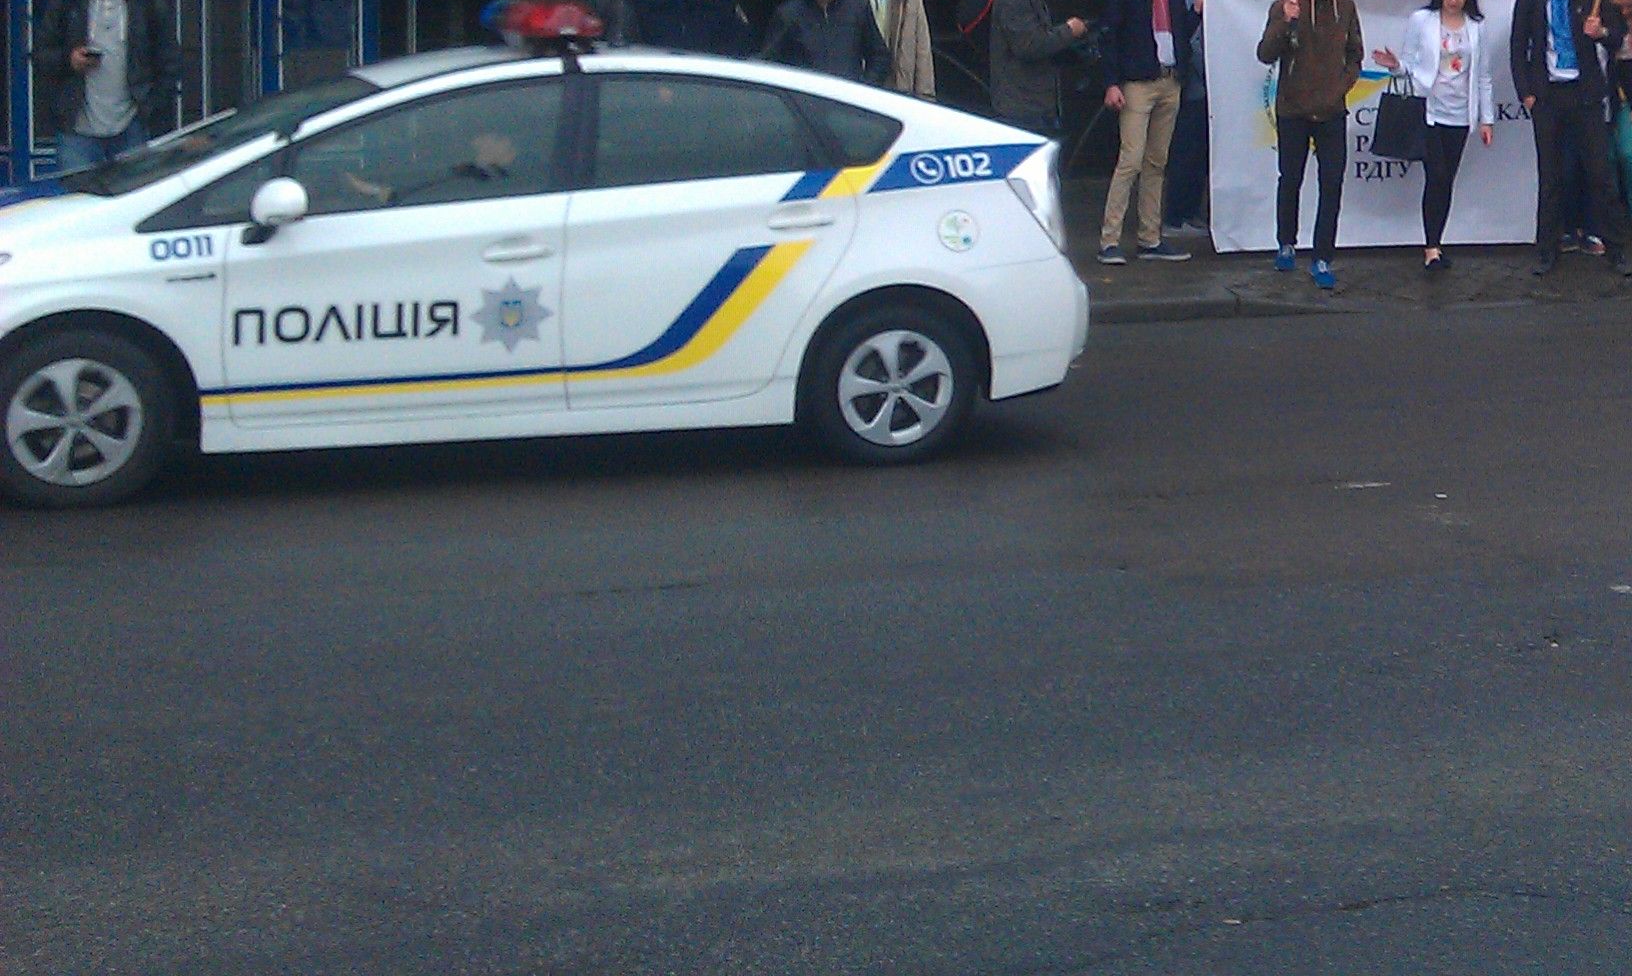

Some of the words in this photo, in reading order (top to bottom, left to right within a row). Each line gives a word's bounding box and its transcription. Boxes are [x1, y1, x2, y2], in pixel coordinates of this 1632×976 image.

[943, 152, 992, 178] 102
[151, 234, 213, 261] 0011
[232, 300, 460, 346] ПОЛІЦІЯ
